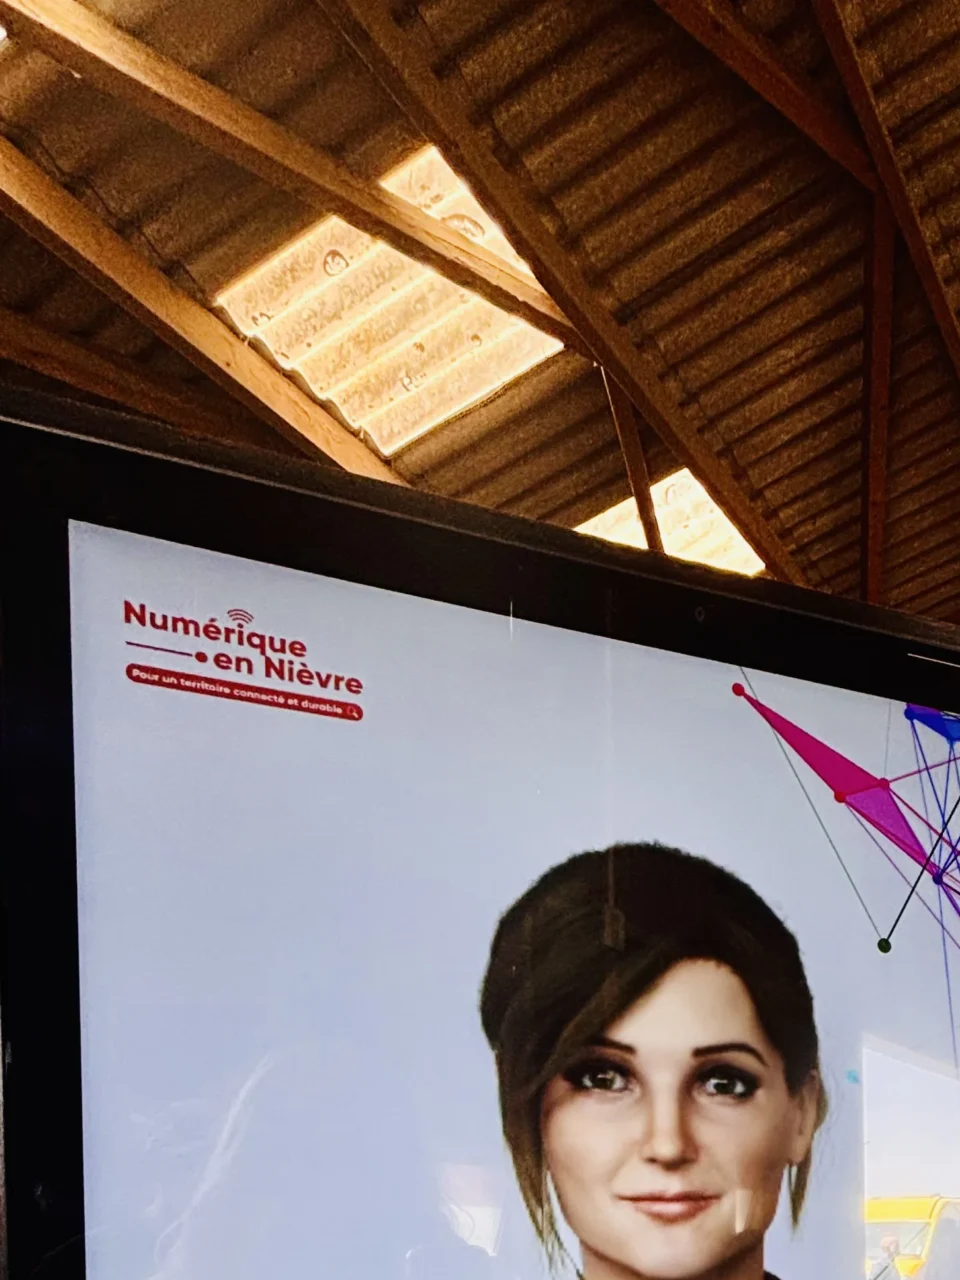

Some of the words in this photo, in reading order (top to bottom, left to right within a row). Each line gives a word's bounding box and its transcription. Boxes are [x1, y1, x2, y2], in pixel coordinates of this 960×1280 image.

[123, 600, 307, 657] Numérique
[132, 668, 159, 682] Pour
[162, 675, 178, 685] un
[180, 678, 231, 694] territoire
[233, 688, 286, 705] connecté
[287, 697, 299, 706] et
[301, 699, 343, 714] durable
[213, 652, 253, 675] en
[264, 655, 364, 695] Nièvre
